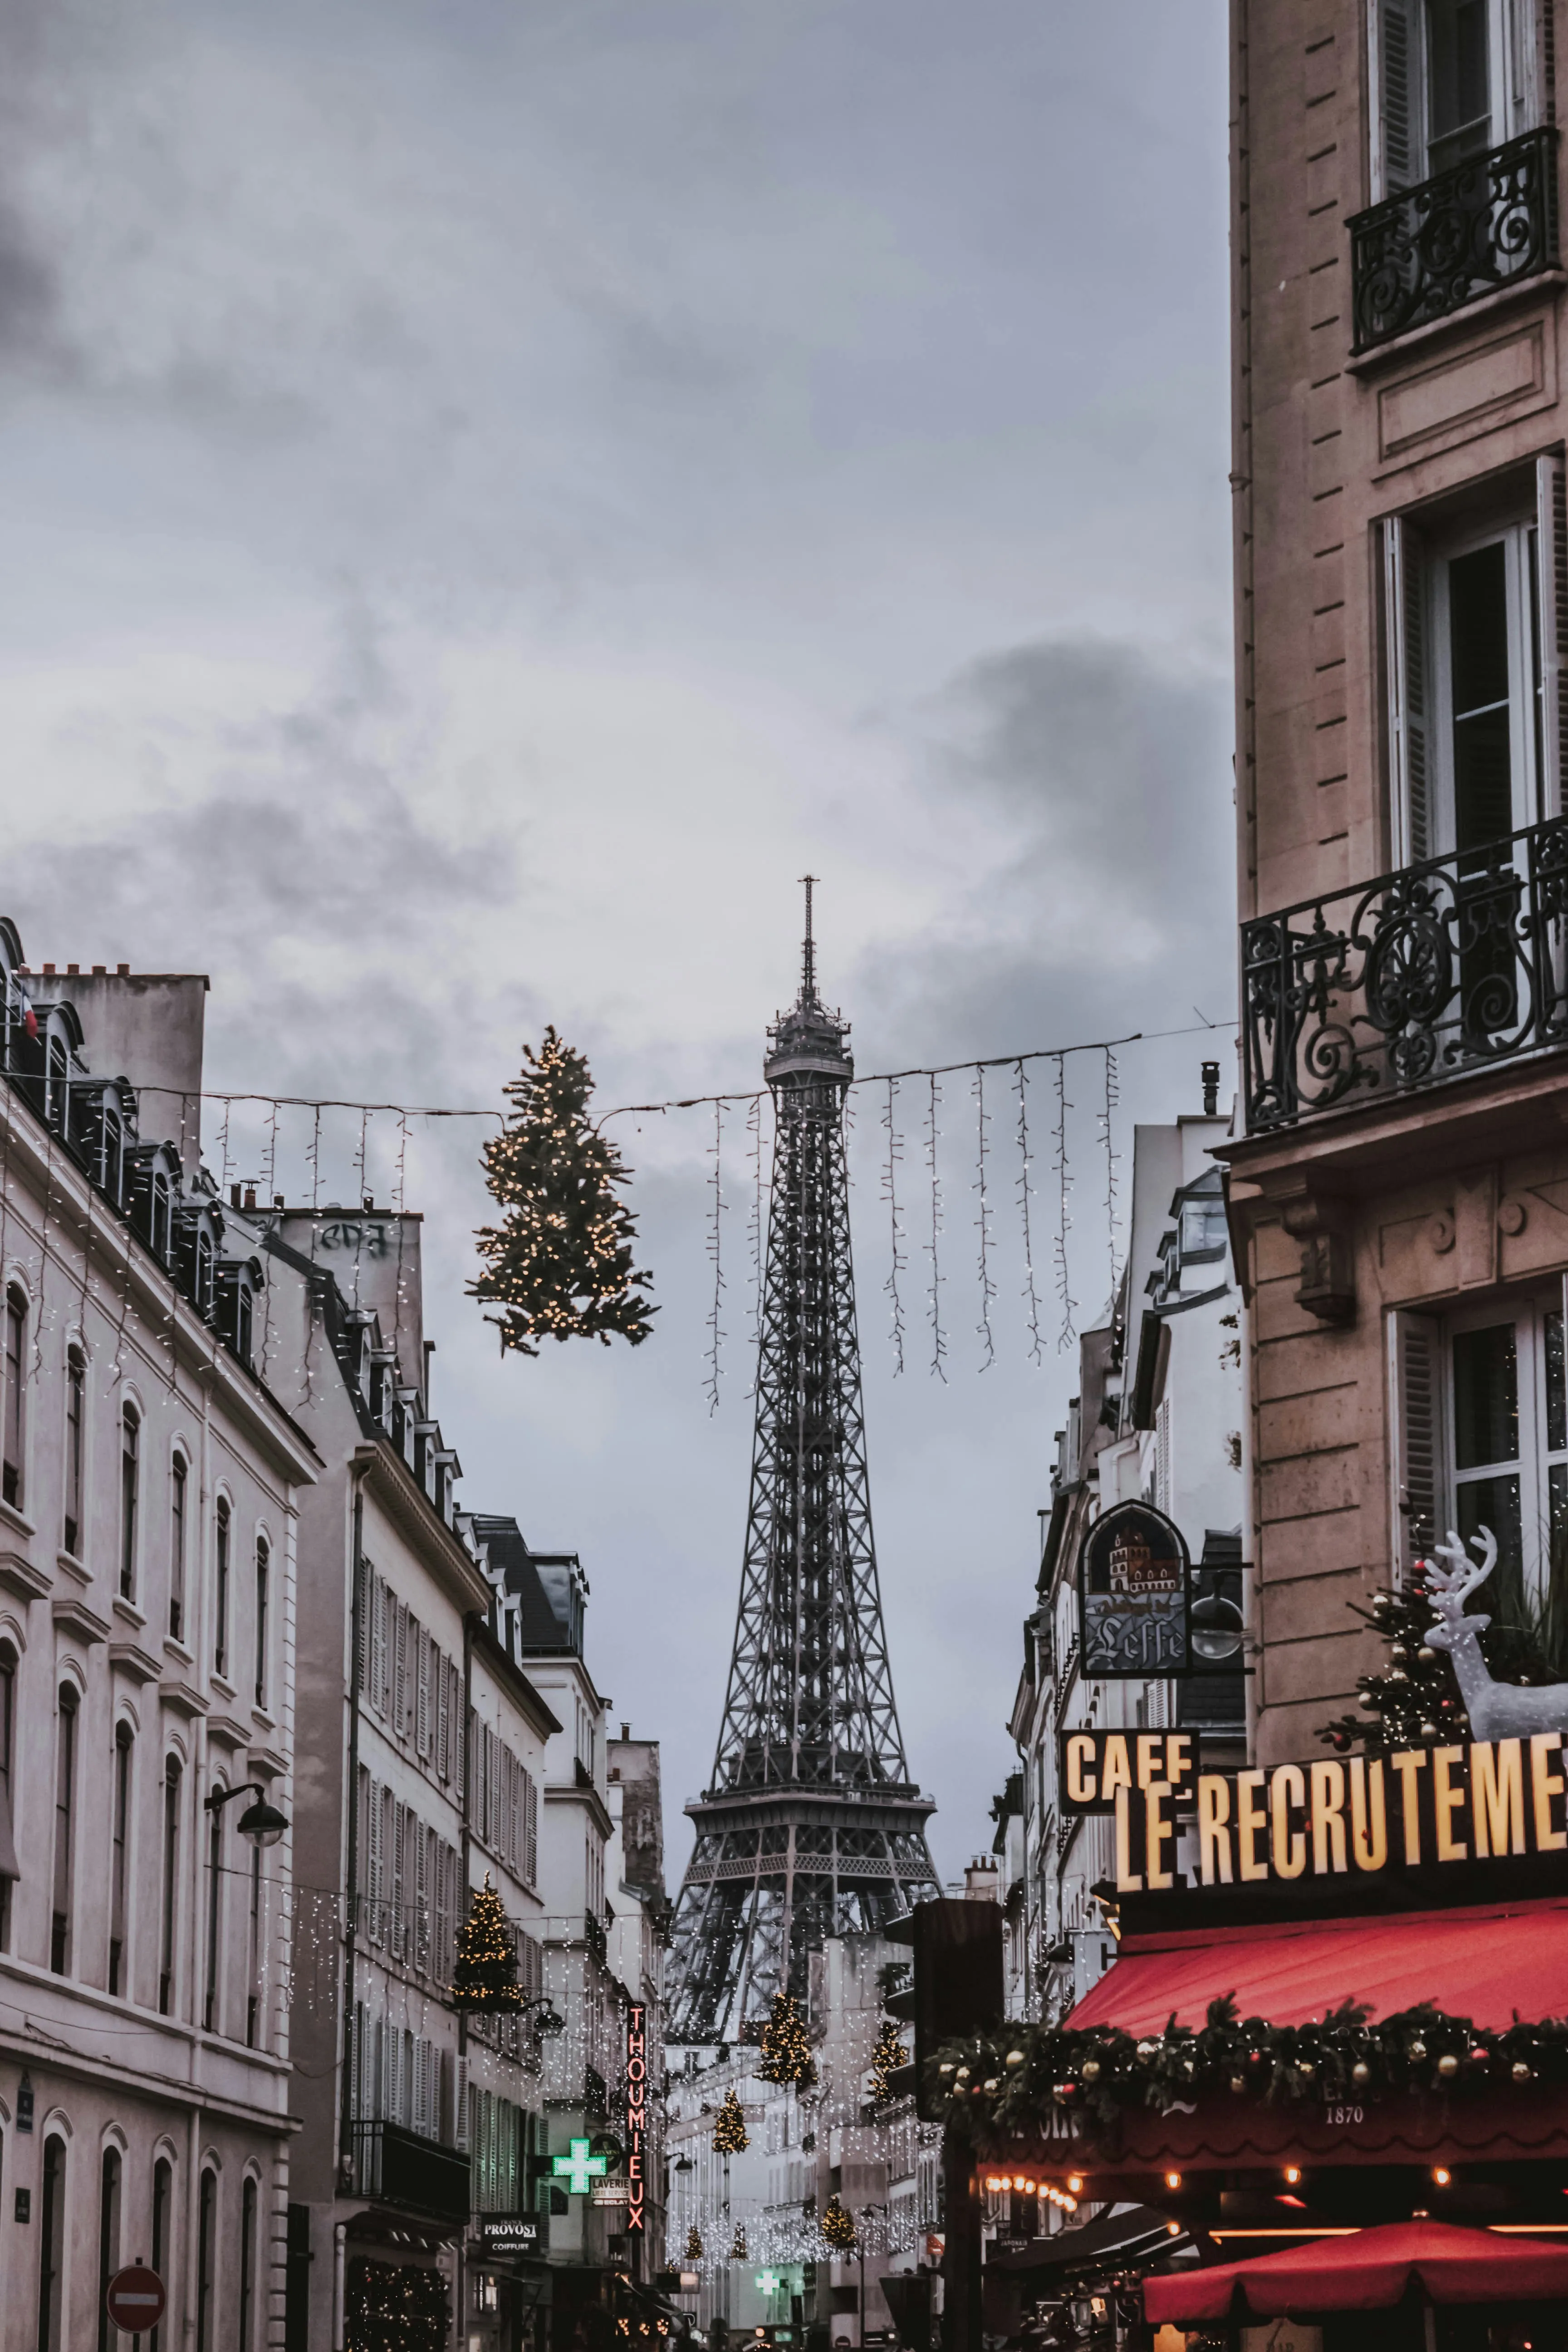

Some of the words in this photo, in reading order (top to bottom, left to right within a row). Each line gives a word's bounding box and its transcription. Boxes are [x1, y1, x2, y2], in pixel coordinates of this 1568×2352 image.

[1092, 1617, 1184, 1664] Leffe
[1116, 1781, 1173, 1892] LE
[1198, 1732, 1568, 1886] RECRUTEME
[628, 2008, 645, 2229] THOUMIEUX
[1326, 2106, 1363, 2124] 1870
[593, 2179, 629, 2189] LAVERIE
[485, 2225, 538, 2235] PROVOST
